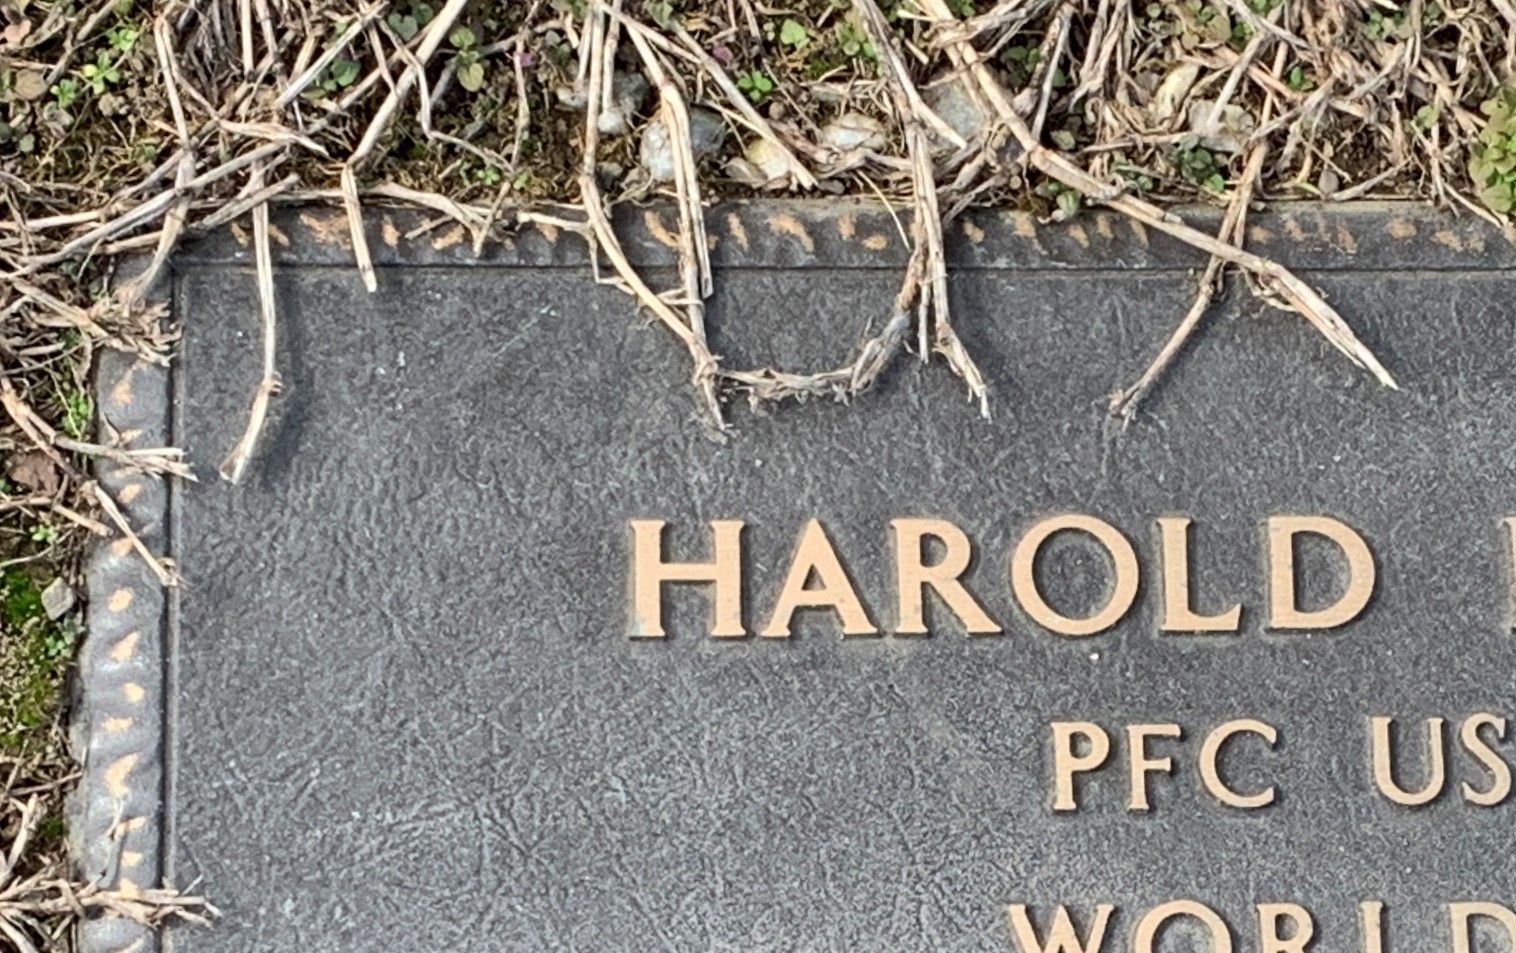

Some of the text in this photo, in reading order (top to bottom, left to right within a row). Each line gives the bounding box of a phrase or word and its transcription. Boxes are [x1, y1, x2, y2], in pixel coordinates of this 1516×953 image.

[626, 512, 1378, 639] HAROLD
[1048, 717, 1279, 813] PFC
[1368, 711, 1512, 807] US
